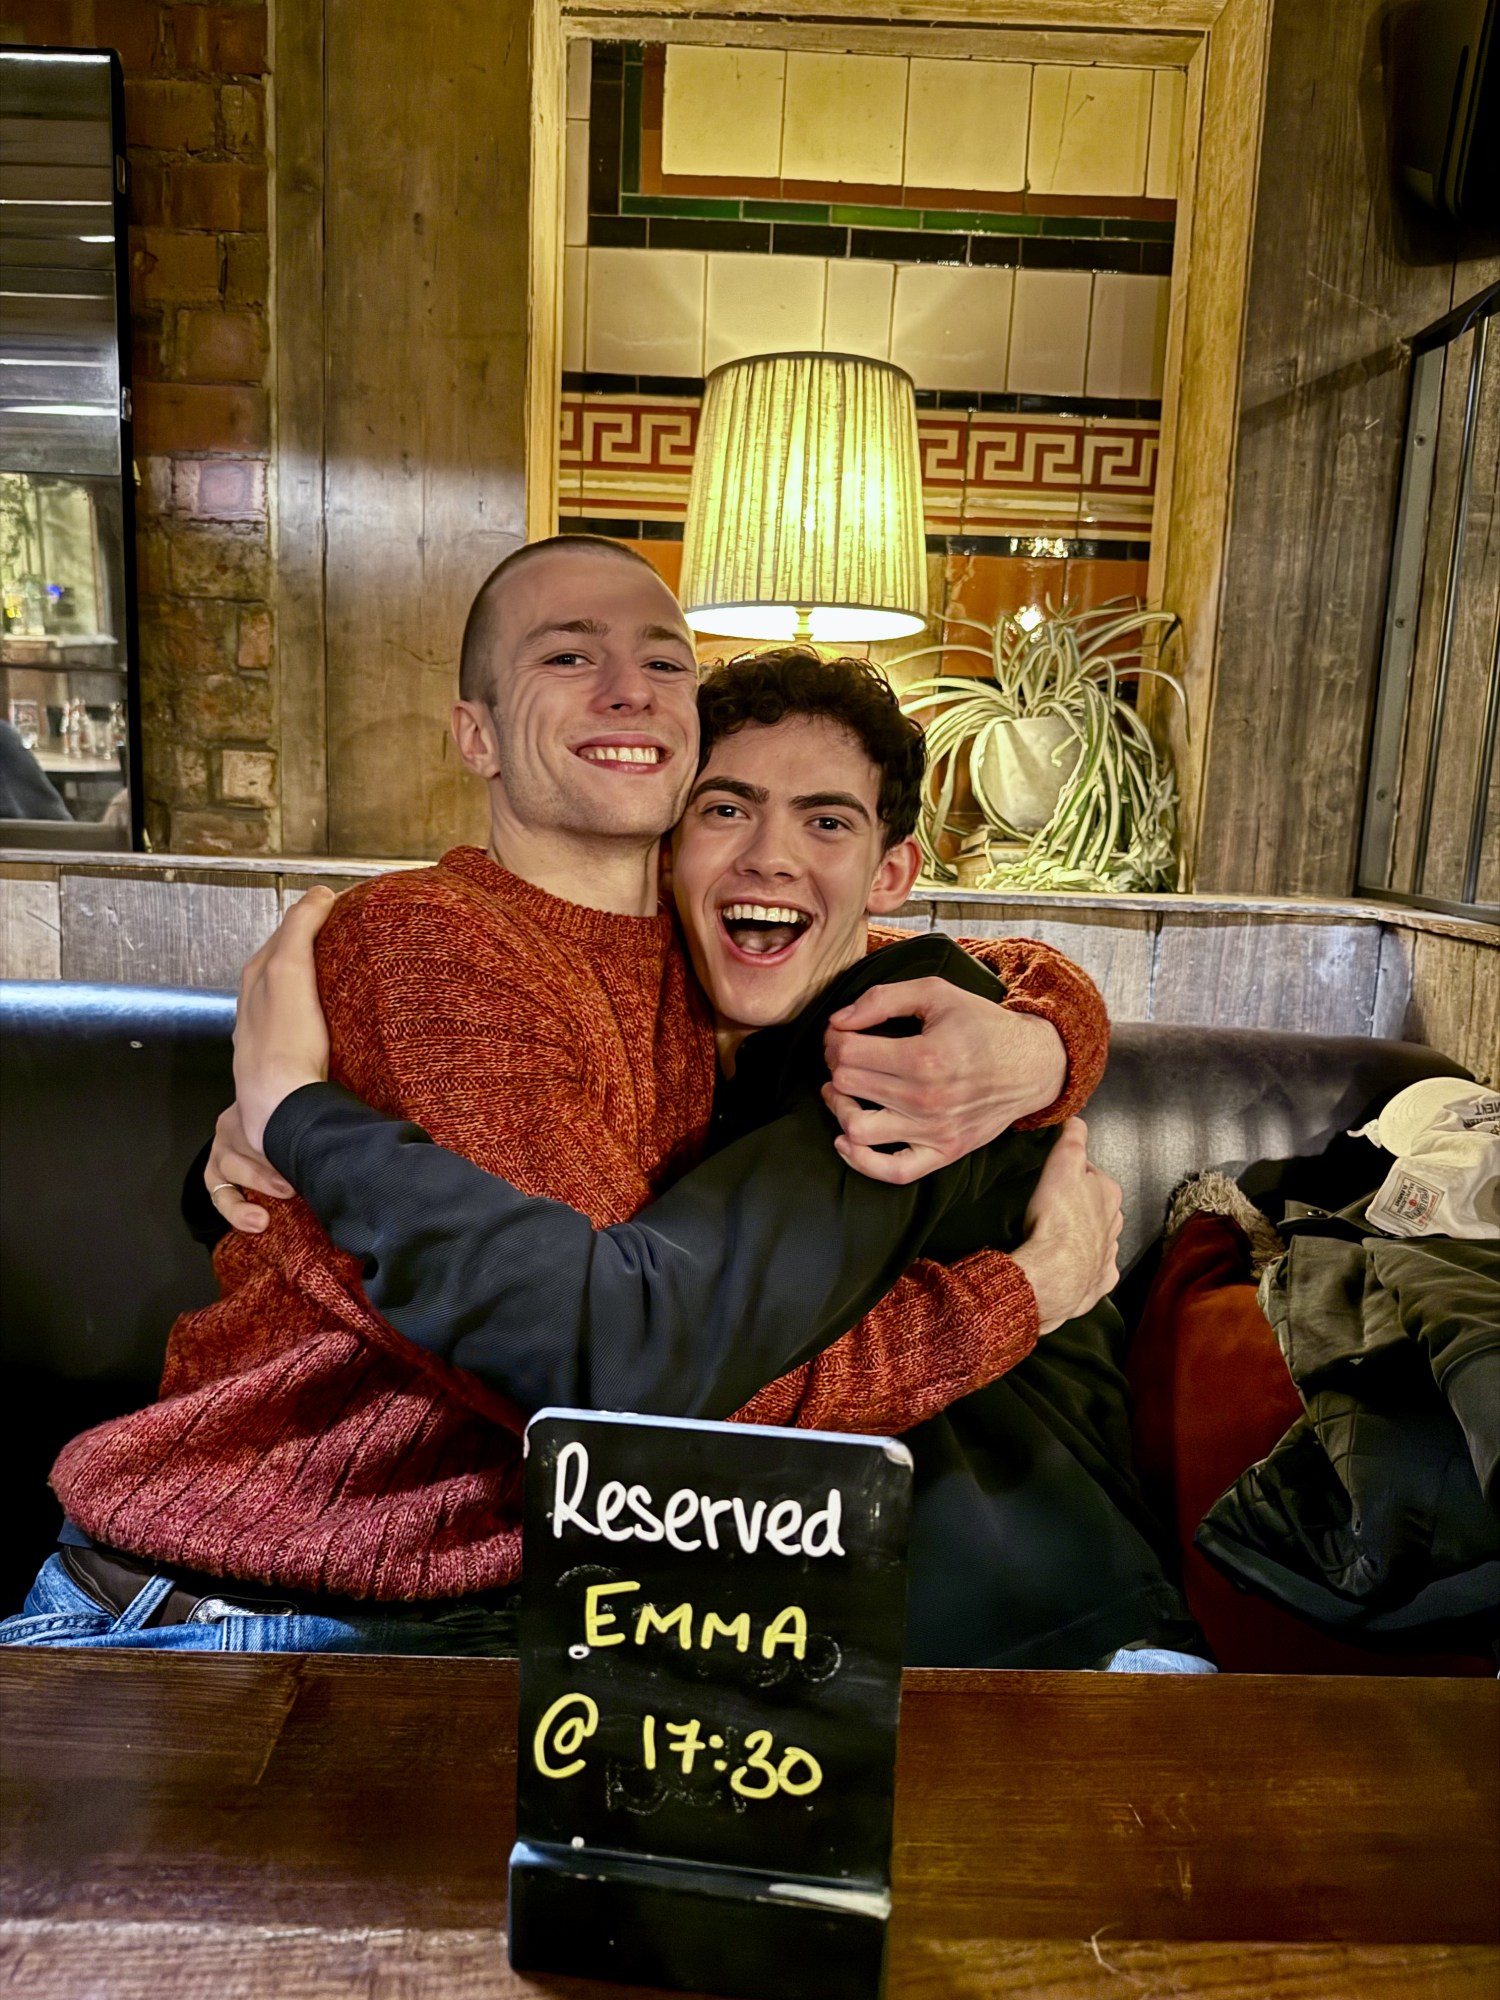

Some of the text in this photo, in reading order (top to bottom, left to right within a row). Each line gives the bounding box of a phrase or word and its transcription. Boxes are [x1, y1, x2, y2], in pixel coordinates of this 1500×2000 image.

[553, 1441, 845, 1557] Reserved
[586, 1581, 807, 1659] EMMA
[534, 1693, 598, 1778] @
[643, 1715, 823, 1798] 17:30
